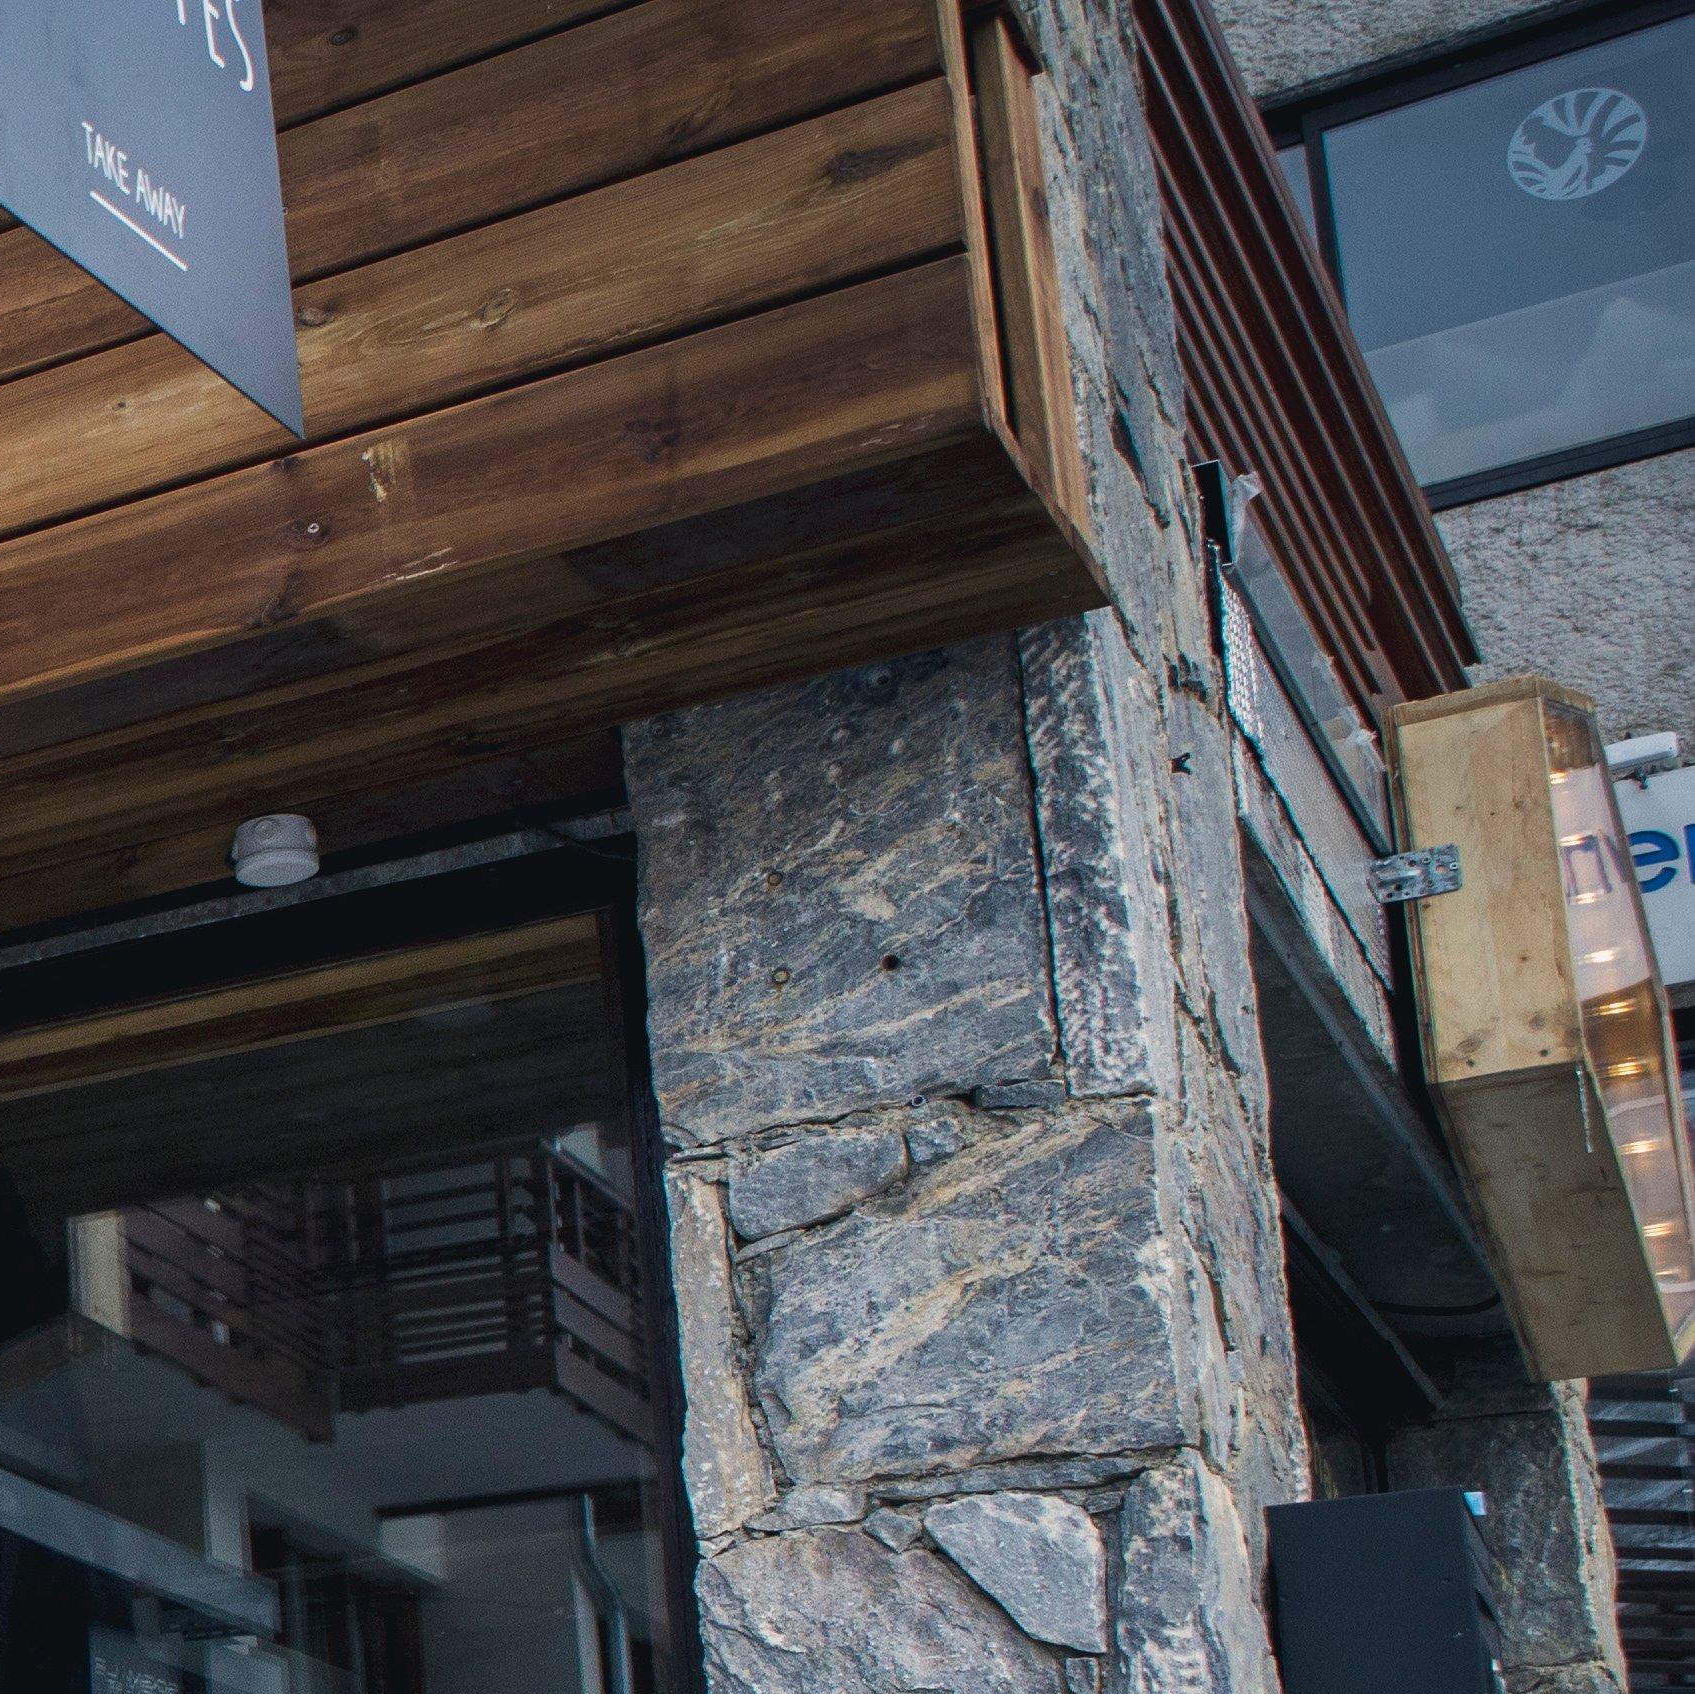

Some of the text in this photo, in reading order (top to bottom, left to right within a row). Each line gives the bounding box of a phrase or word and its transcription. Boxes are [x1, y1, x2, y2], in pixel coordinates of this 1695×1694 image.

[175, 0, 254, 92] ES
[82, 122, 186, 239] TAKE AWAY
